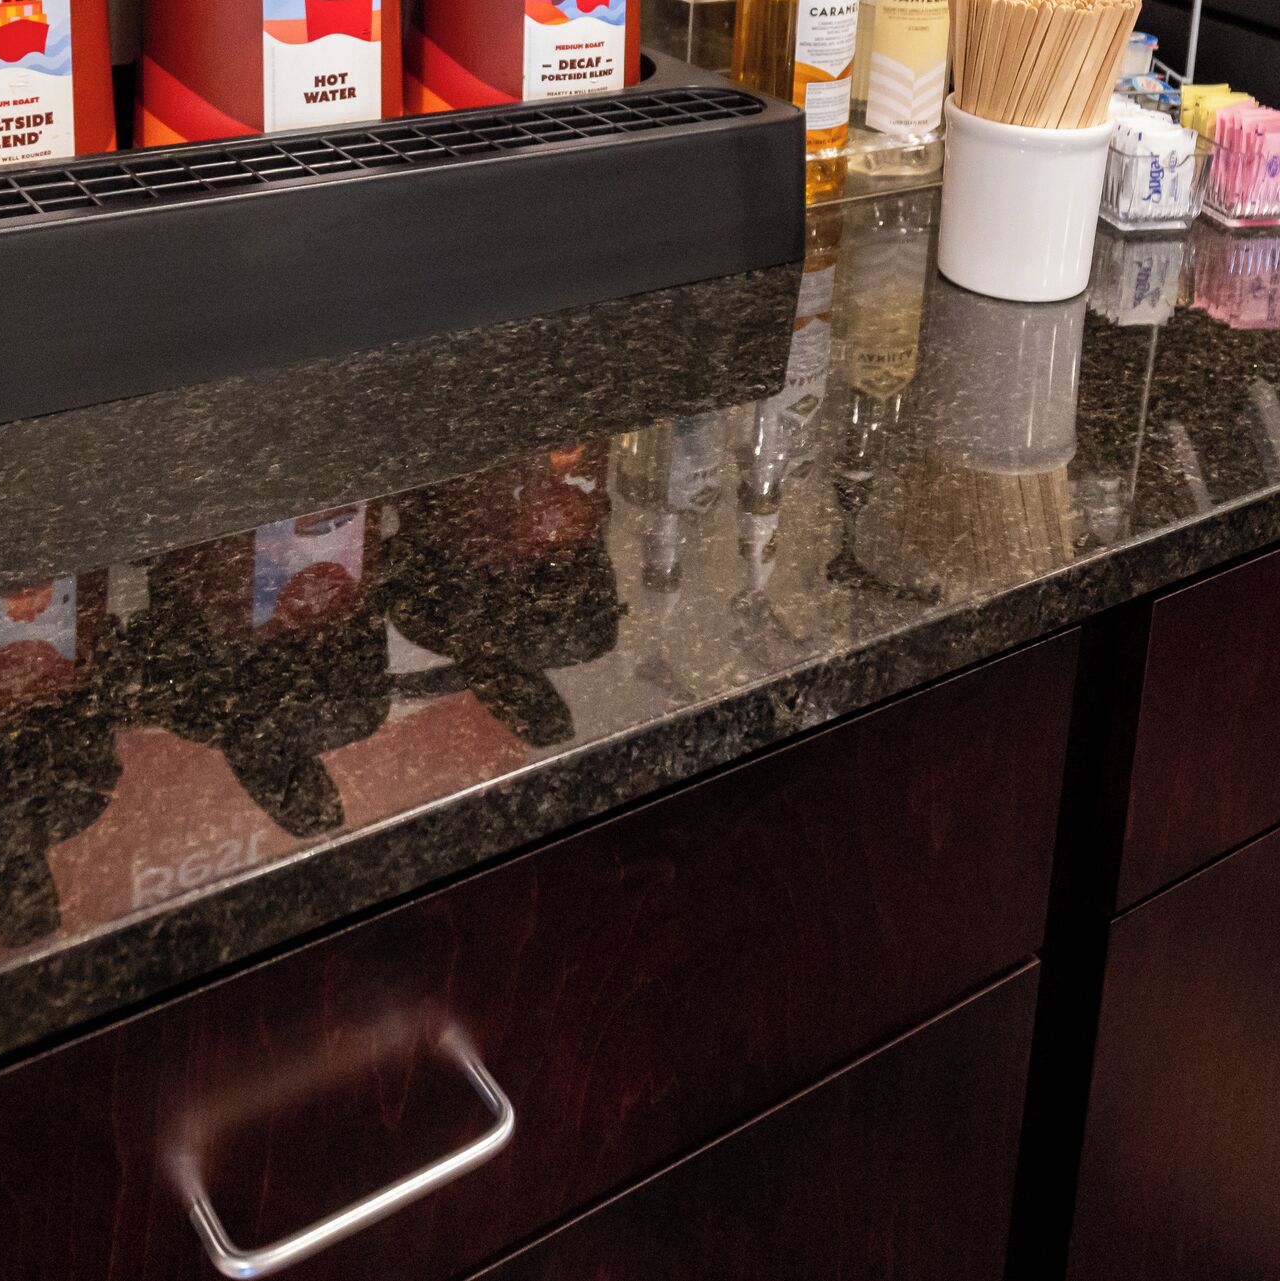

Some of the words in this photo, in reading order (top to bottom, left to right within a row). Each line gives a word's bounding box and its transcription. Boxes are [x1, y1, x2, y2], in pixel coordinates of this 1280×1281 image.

[559, 57, 601, 70] DECAF
[314, 73, 348, 87] HOT
[541, 73, 587, 81] PORTSIDE
[304, 87, 356, 104] WATER
[13, 97, 40, 105] ROAST
[22, 151, 51, 159] ROUNDED
